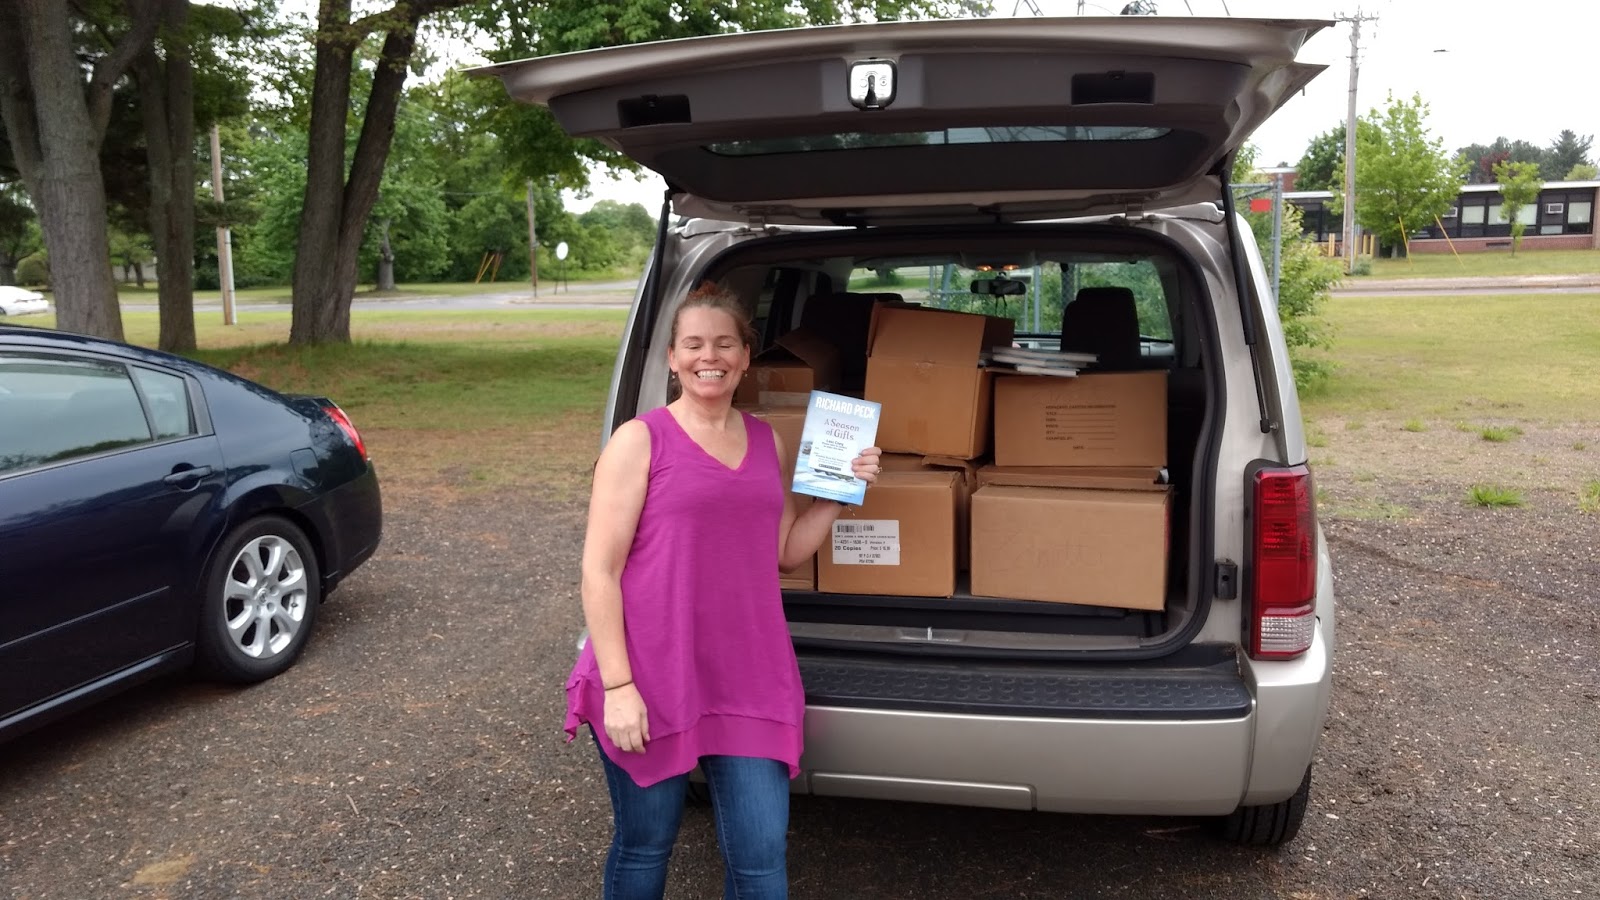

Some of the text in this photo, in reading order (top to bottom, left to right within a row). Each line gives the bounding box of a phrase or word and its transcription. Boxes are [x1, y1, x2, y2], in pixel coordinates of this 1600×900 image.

[815, 396, 876, 419] RICHARD PECK
[824, 418, 860, 432] A Season
[825, 428, 855, 441] of Gifts
